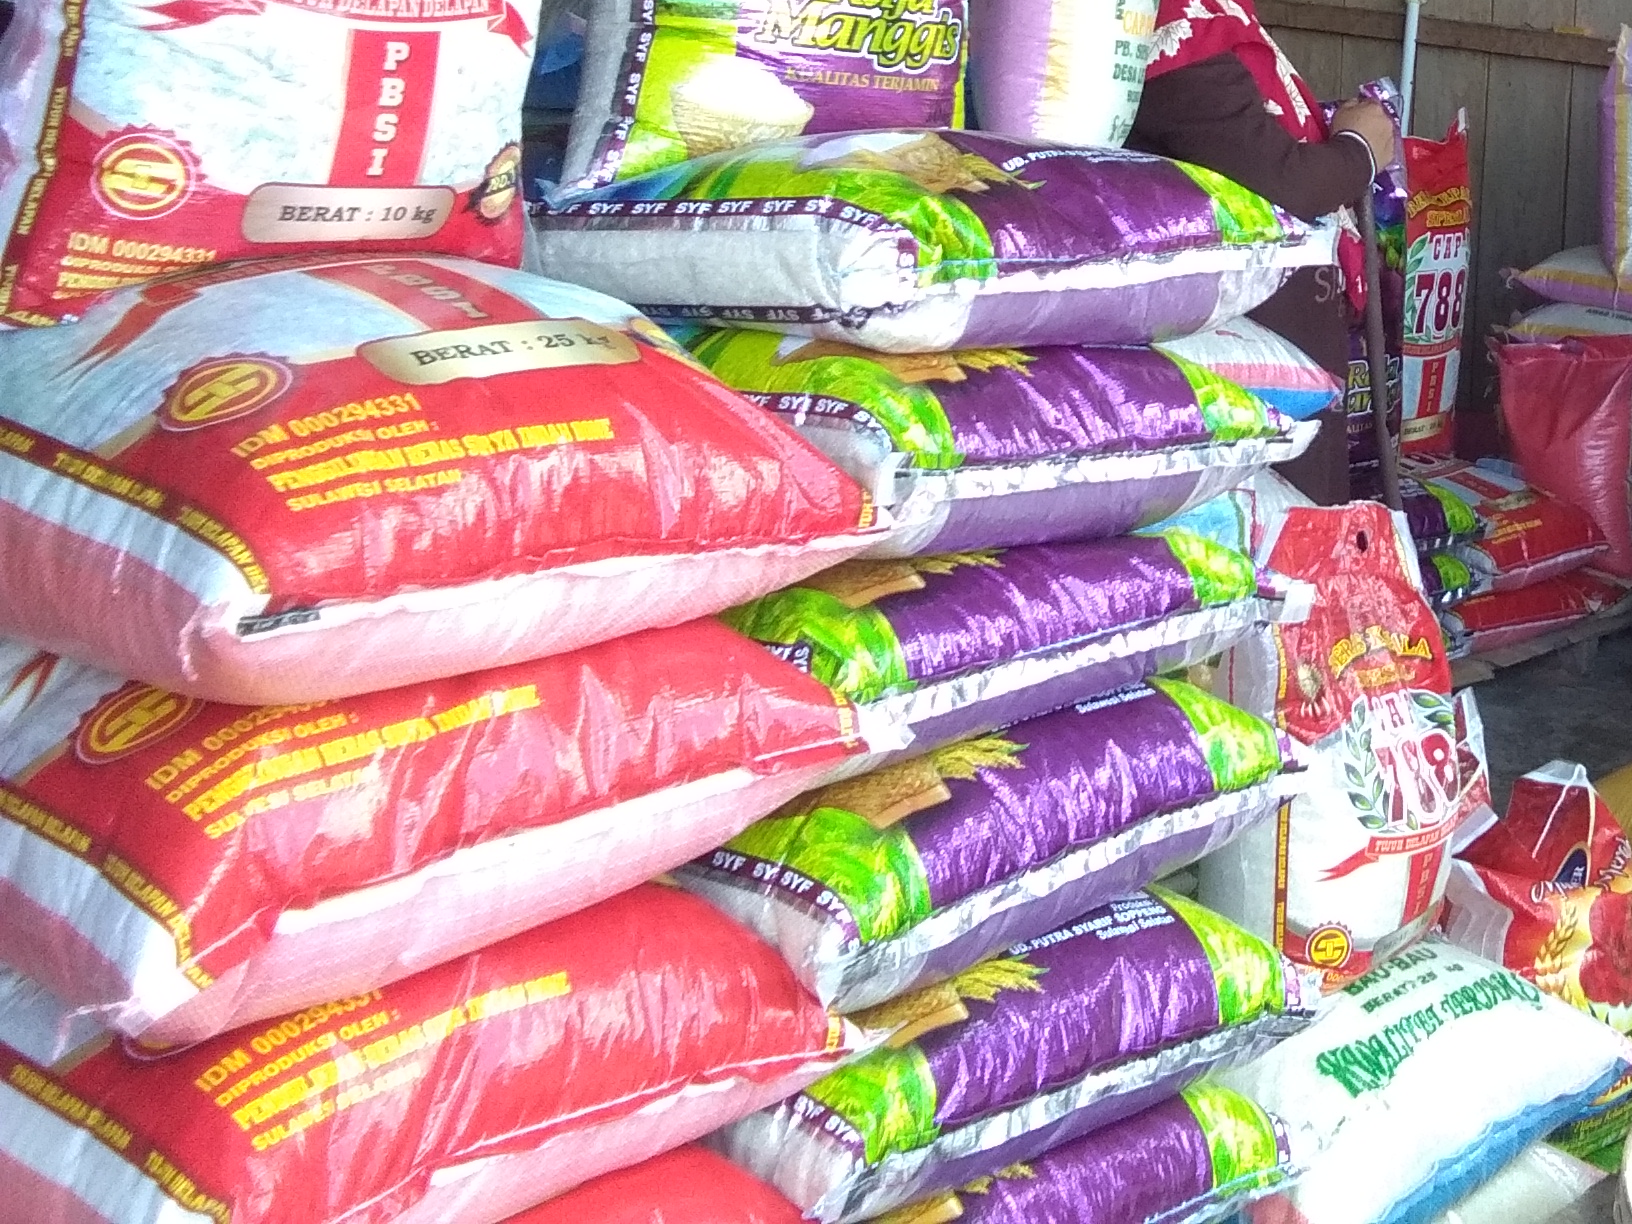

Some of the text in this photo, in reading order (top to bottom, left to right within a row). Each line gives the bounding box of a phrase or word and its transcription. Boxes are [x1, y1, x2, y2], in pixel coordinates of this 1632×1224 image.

[634, 32, 653, 63] SYF
[624, 72, 641, 106] SYF
[783, 66, 941, 94] KALITAS TERJAMIN
[366, 40, 411, 177] PBSI
[1001, 156, 1029, 172] UD.
[277, 204, 361, 223] BERAT
[379, 205, 408, 223] 10
[411, 204, 438, 228] kg
[588, 202, 624, 215] SYF
[631, 201, 668, 215] SYF
[675, 201, 712, 215] SYF
[718, 200, 752, 214] SYF
[762, 199, 797, 214] SYF
[840, 204, 876, 227] SYF
[68, 231, 111, 255] IDM
[1432, 234, 1462, 261] CAP
[722, 307, 755, 320] SYF
[766, 309, 800, 322] SYF
[1413, 269, 1467, 336] 788
[409, 339, 513, 367] BERAT
[537, 333, 575, 350] 25
[815, 398, 850, 414] SYF
[231, 391, 423, 459] IDM 000294331
[249, 428, 376, 471] DIPRODUKSI
[376, 418, 430, 441] OLEH
[145, 747, 203, 791] IDM
[164, 726, 293, 805] DIPRODUKSI
[294, 713, 349, 739] OLEH
[1374, 839, 1404, 853] TUJUH
[712, 850, 747, 872] SYF
[780, 870, 815, 894] SYF
[1008, 943, 1032, 957] UD.
[1031, 929, 1075, 951] PUTRA
[1360, 983, 1410, 1015] BERAT
[194, 1047, 252, 1094] IDM
[214, 1030, 339, 1109] DIPRODUKSI
[338, 1010, 391, 1041] OLEH
